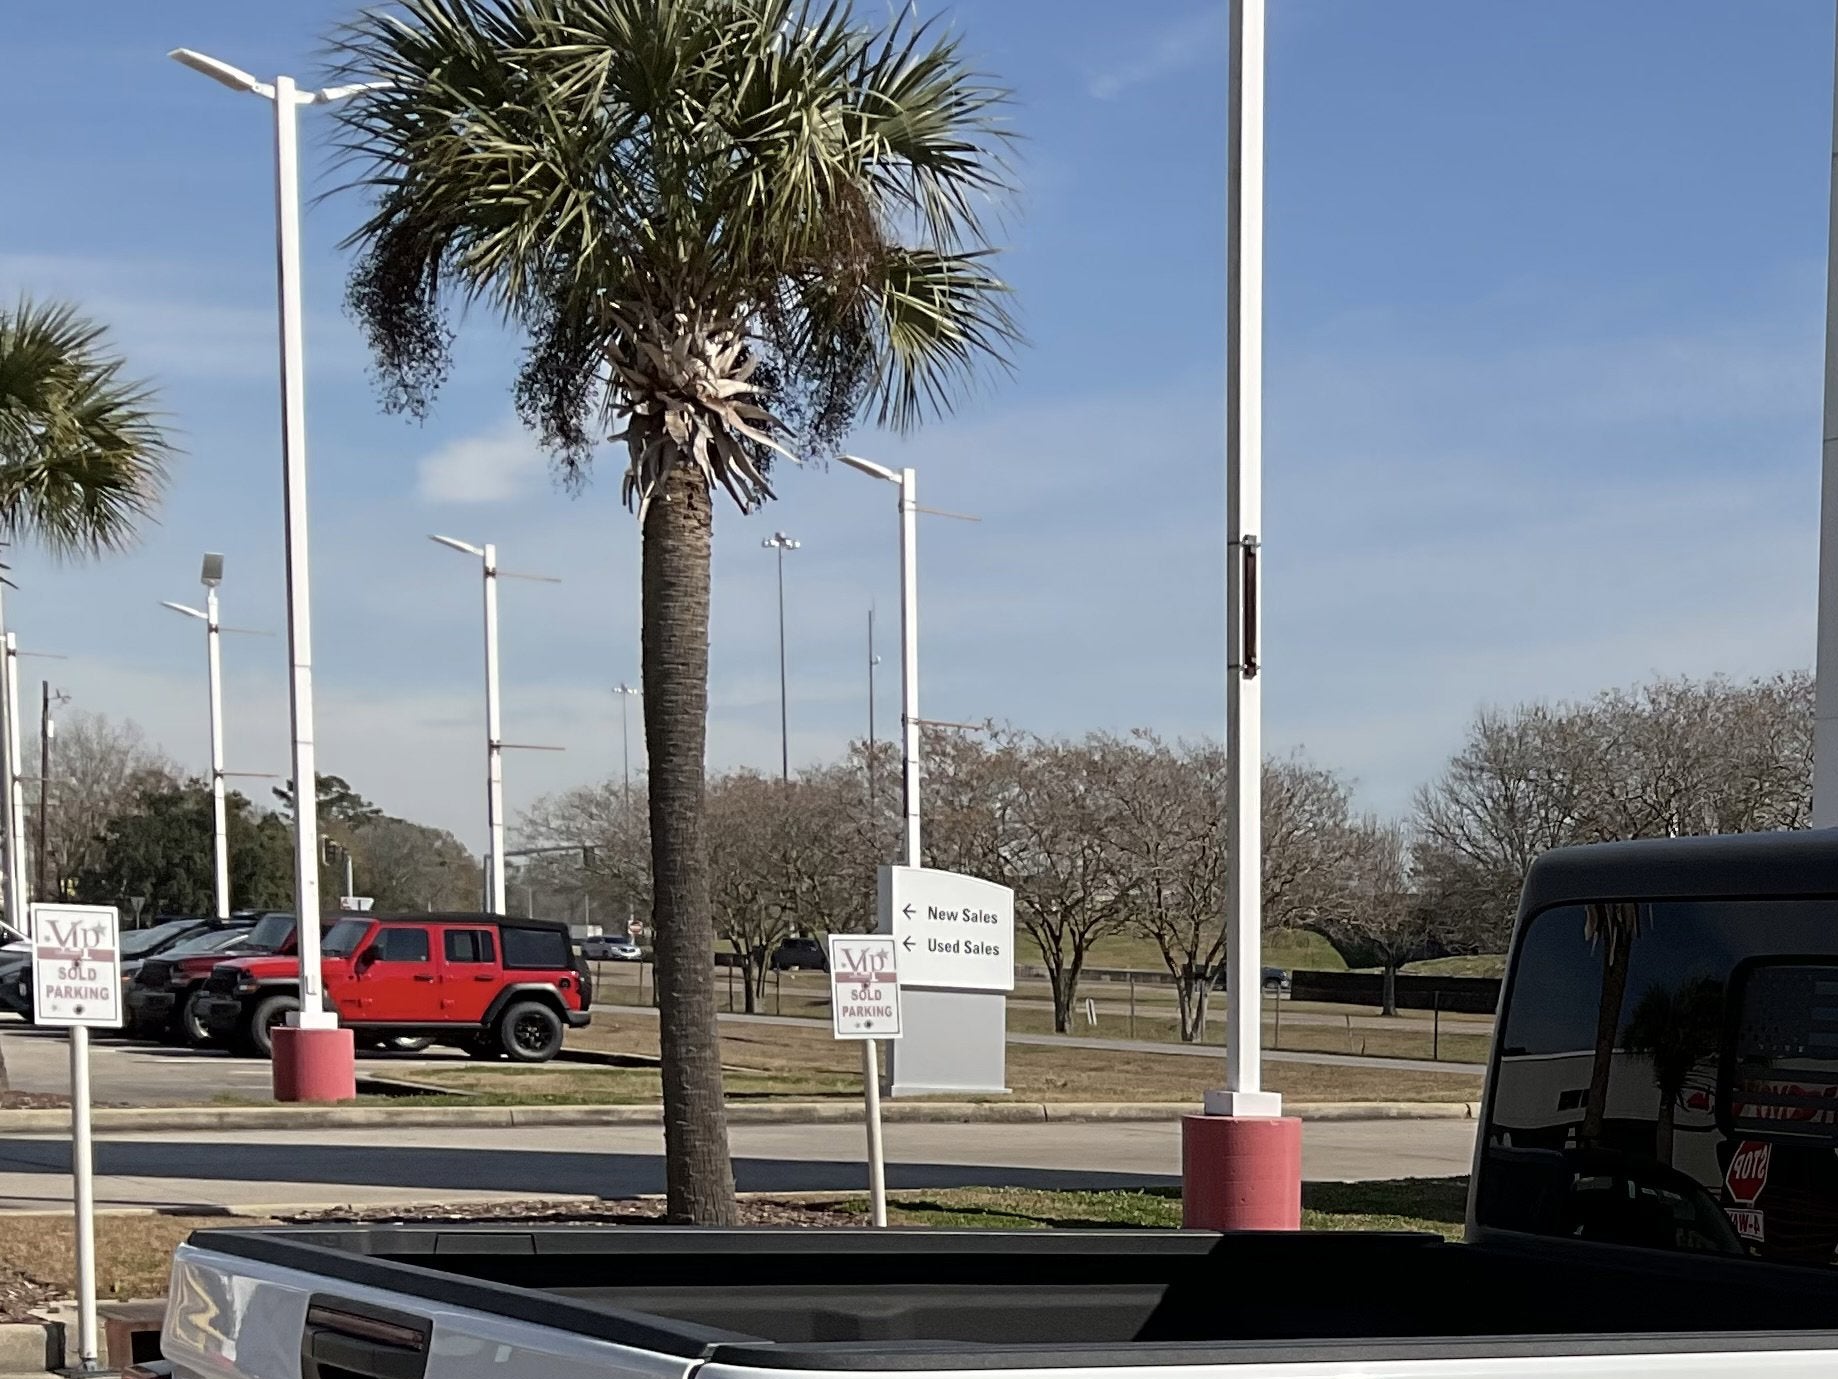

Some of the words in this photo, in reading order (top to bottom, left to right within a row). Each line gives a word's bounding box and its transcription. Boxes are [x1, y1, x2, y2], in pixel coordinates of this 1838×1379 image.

[928, 906, 958, 921] New
[962, 908, 998, 924] Sales
[928, 938, 960, 954] Used
[964, 940, 1000, 956] Sales
[58, 966, 97, 981] SOLD
[46, 985, 110, 1000] PARKING
[851, 989, 882, 1001] SOLD
[842, 1005, 893, 1018] PARKING
